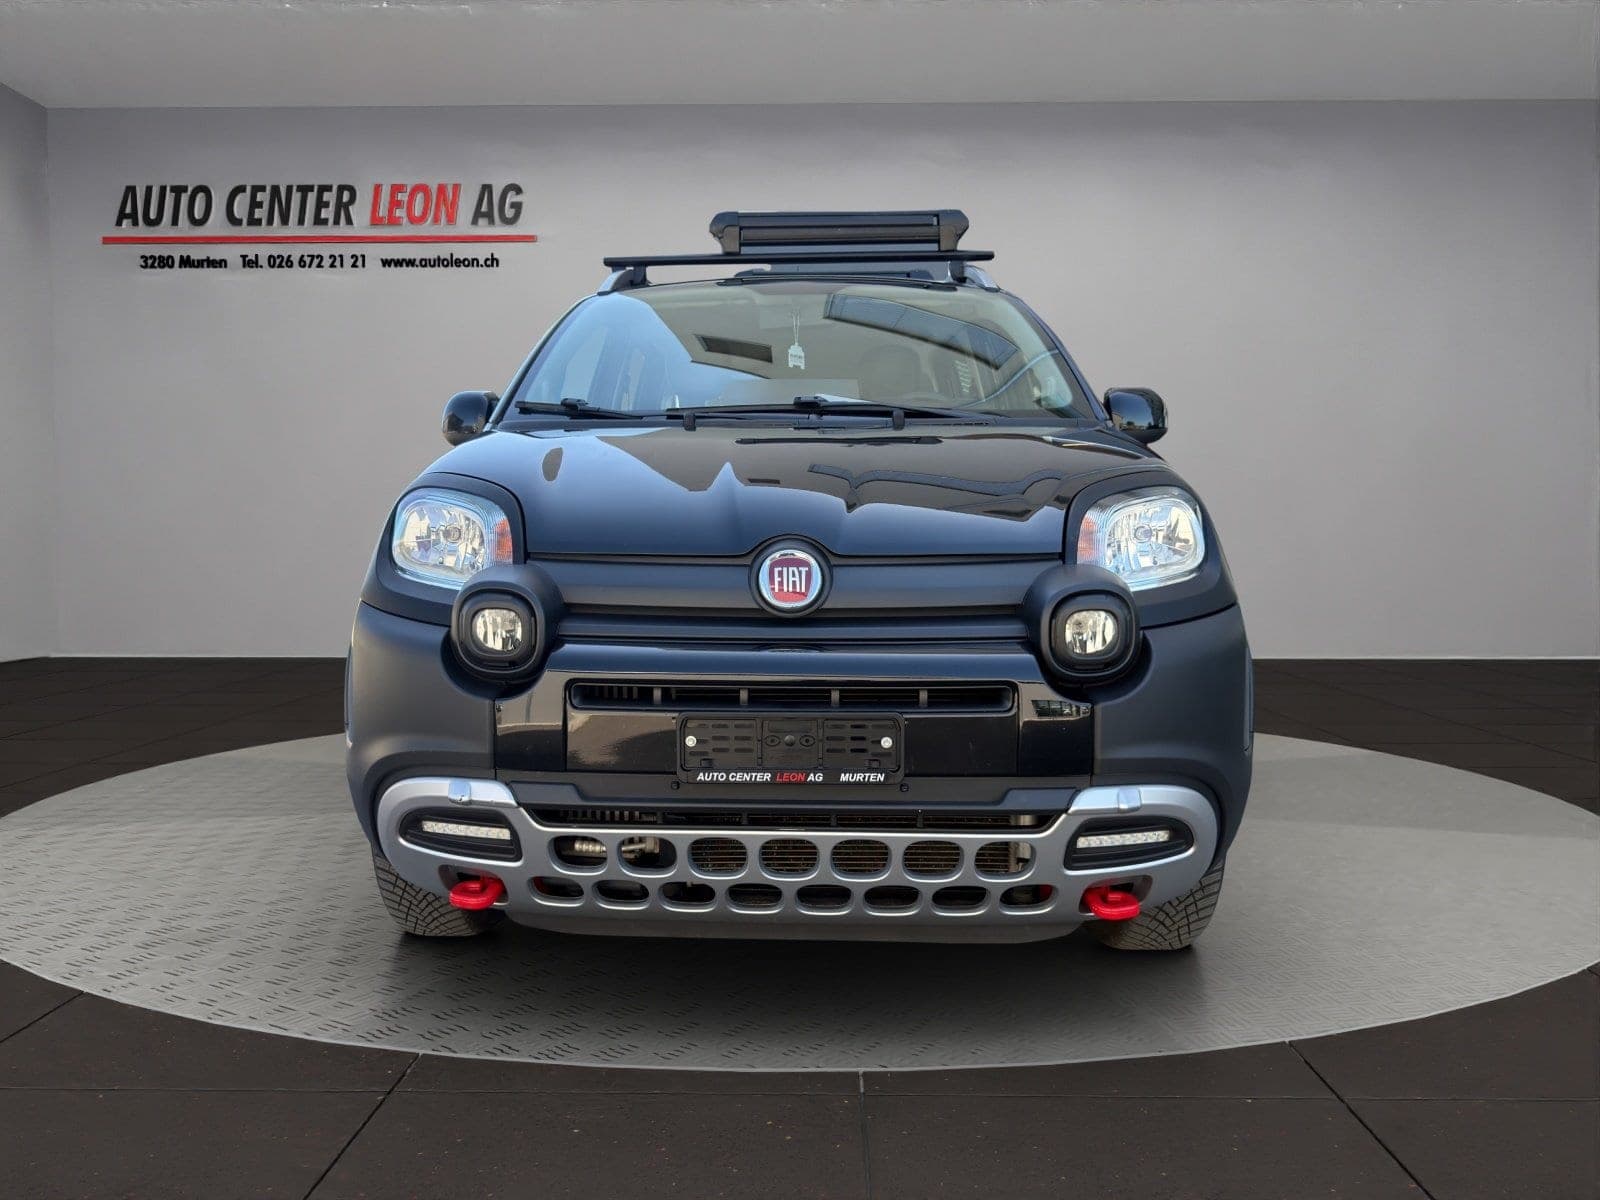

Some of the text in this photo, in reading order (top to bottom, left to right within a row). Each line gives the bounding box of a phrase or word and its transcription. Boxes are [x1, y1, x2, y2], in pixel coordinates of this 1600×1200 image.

[115, 183, 524, 228] AUTO CENTER LEON AG
[139, 252, 500, 270] 3280 Murten Tel. 026 672 21 21 www.autoleon.ch
[774, 567, 809, 593] FIAT
[697, 772, 885, 782] AUTO CENTER LEON AG MURTEN
